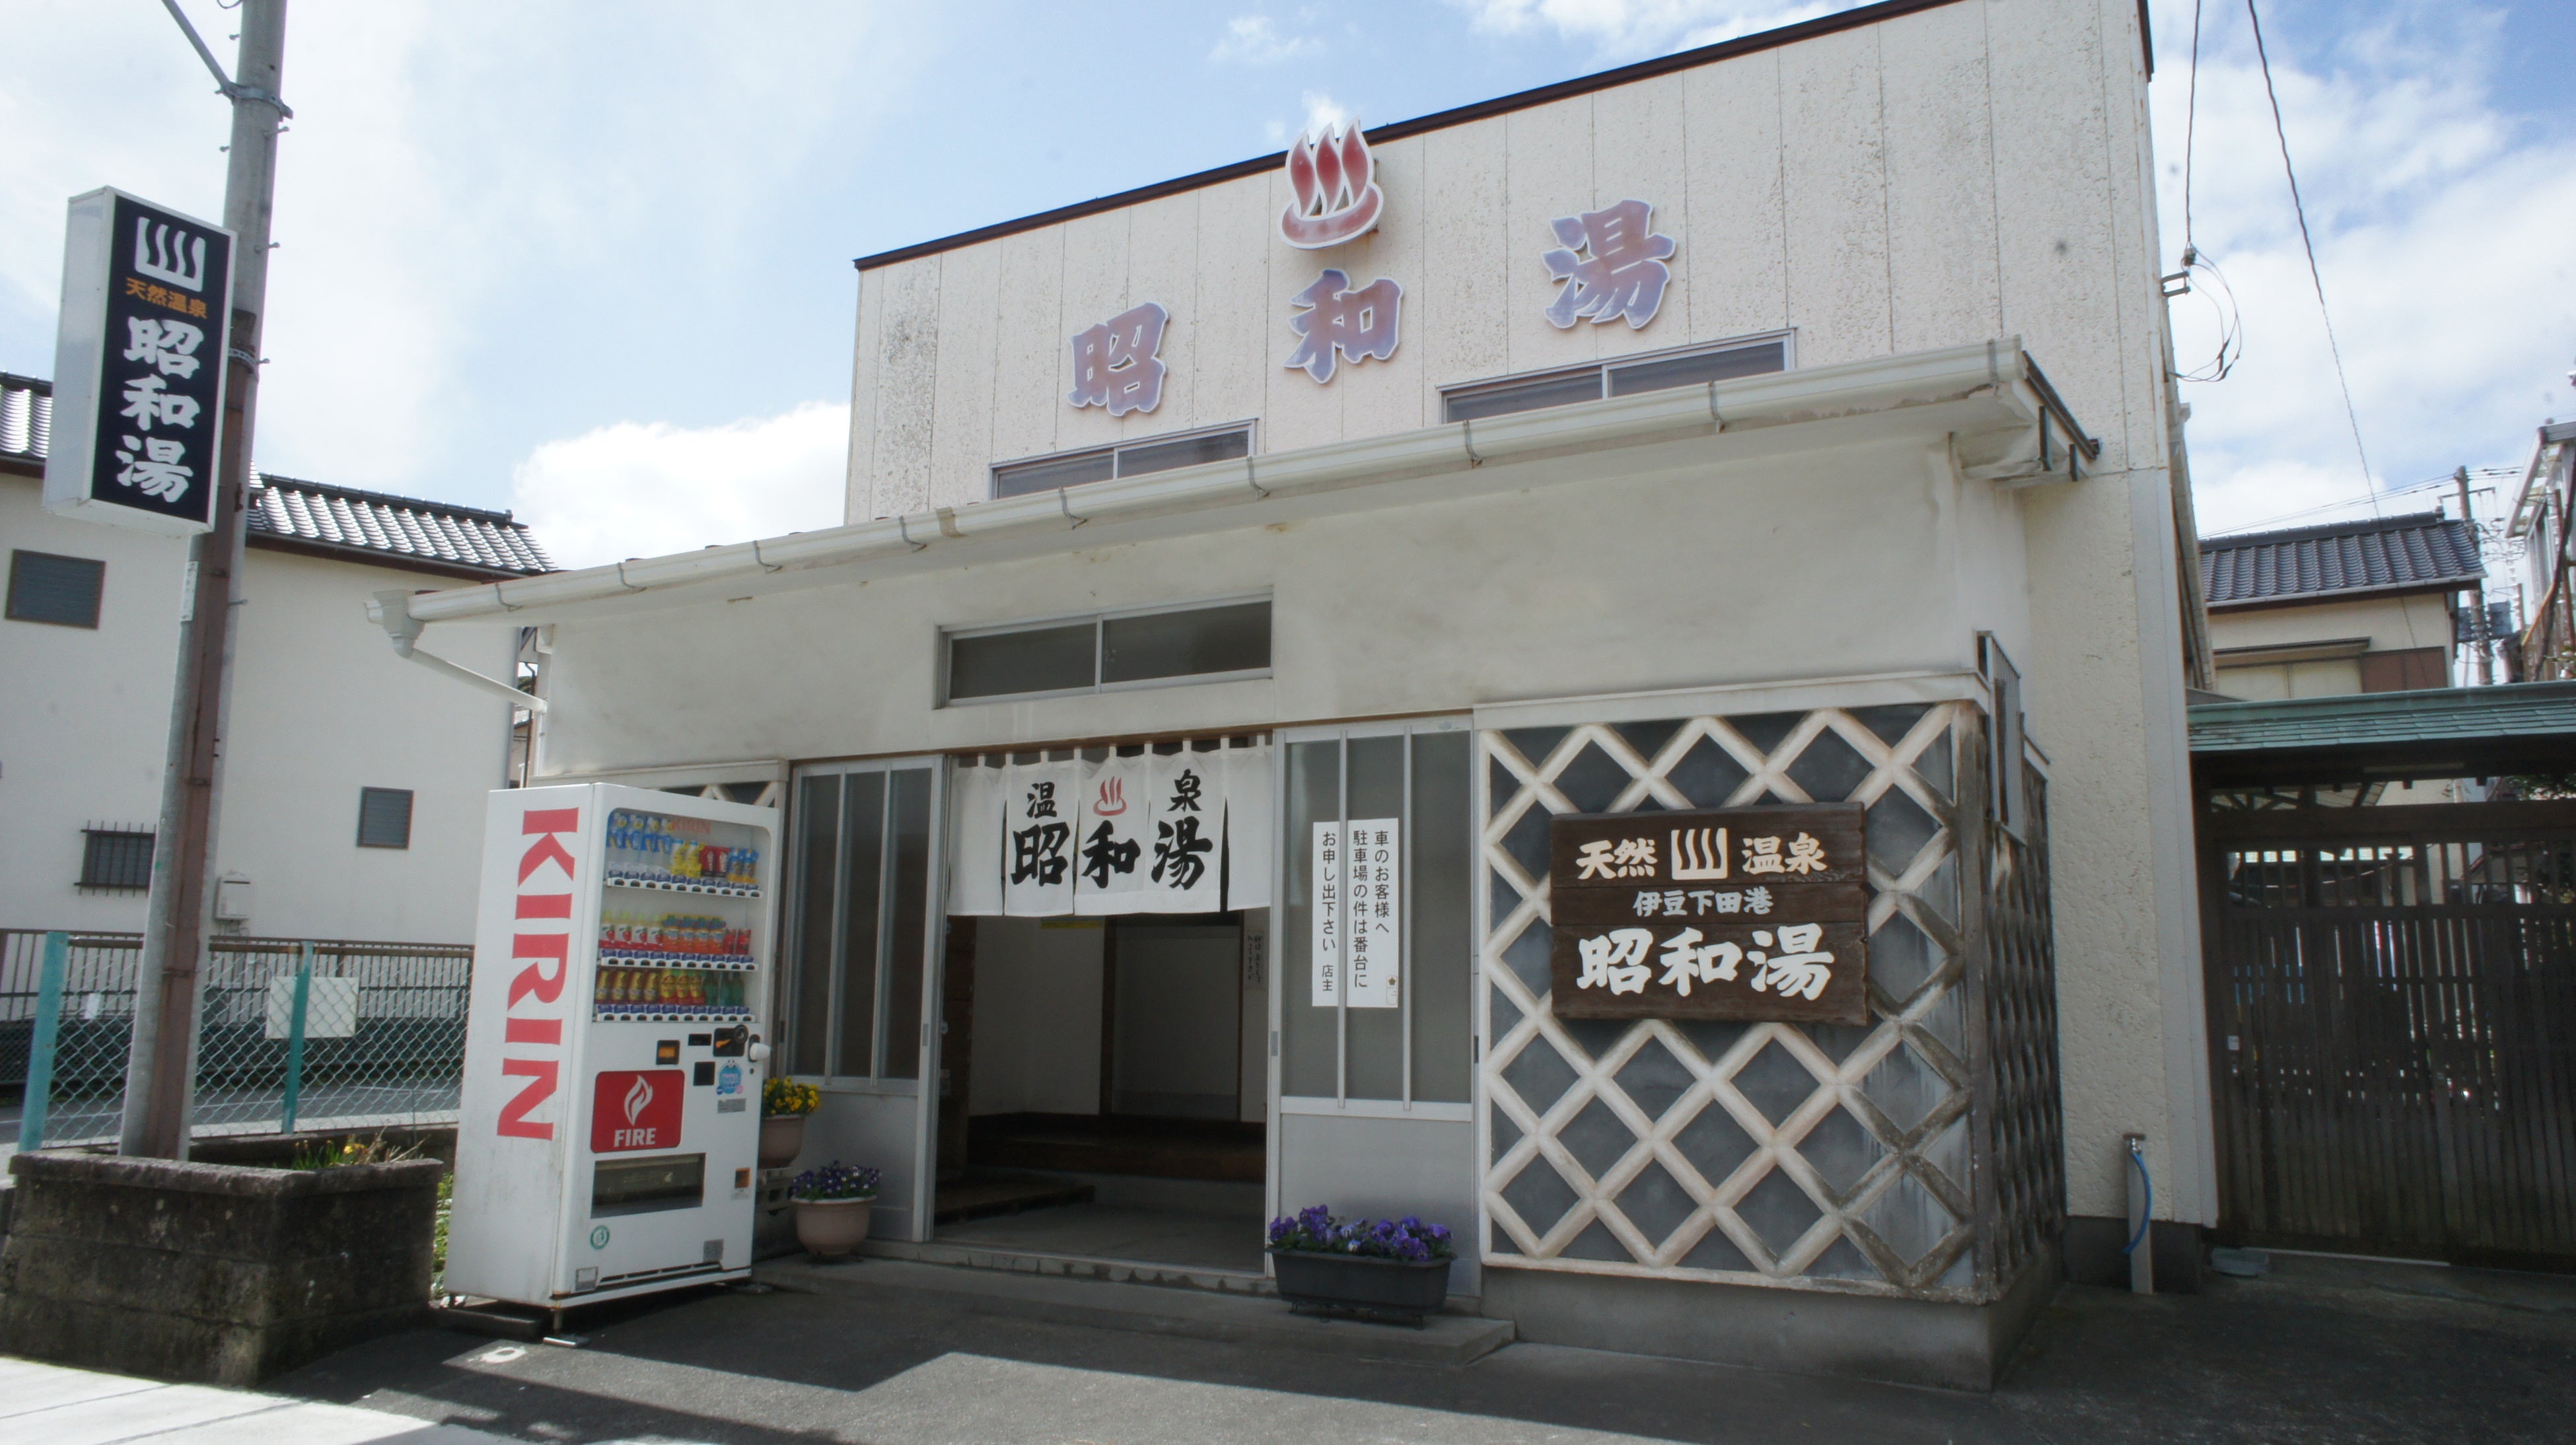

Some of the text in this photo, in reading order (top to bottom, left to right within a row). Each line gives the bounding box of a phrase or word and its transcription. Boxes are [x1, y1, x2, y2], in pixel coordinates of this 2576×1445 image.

[125, 277, 208, 319] 天然温泉
[1067, 199, 1676, 417] 昭和湯
[114, 316, 204, 503] 昭和湯
[1011, 816, 1213, 891] 昭和湯
[1375, 830, 1390, 933] 車のお客様へ
[1576, 831, 1828, 880] 天然 温泉
[1322, 831, 1336, 991] お申し出下さい 店主
[1353, 829, 1368, 988] 駐車場の件は番台に
[1632, 886, 1773, 917] 伊豆下田港
[496, 807, 579, 1141] KIRIN
[1576, 923, 1835, 1001] 昭和湯
[614, 1127, 657, 1148] FIRE
